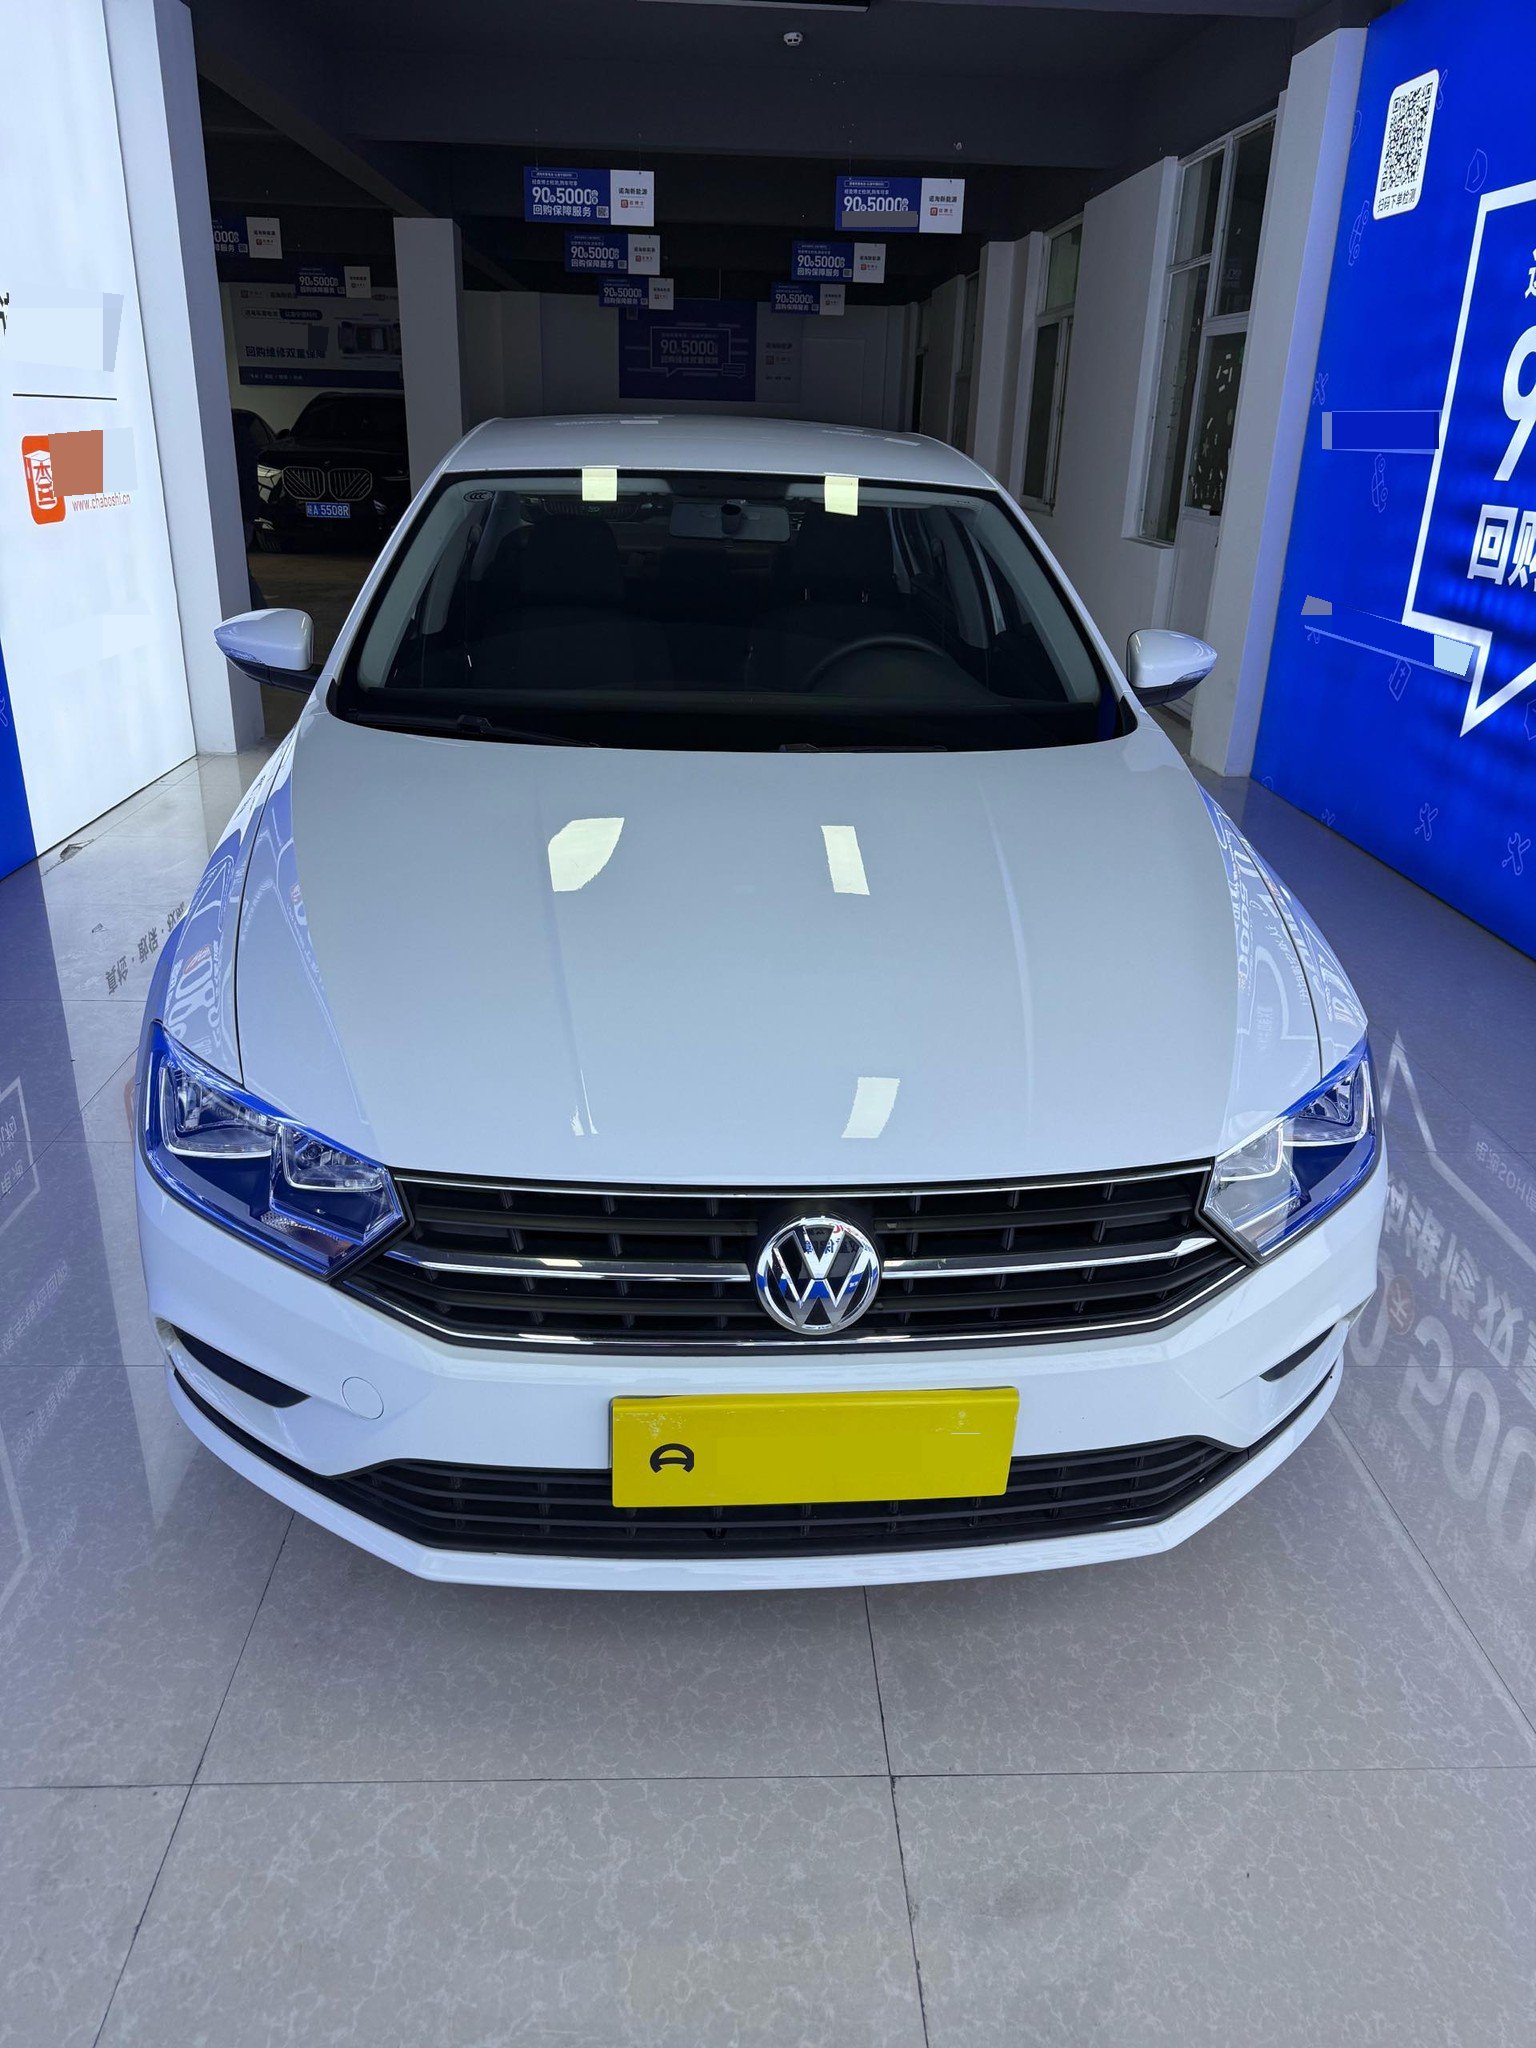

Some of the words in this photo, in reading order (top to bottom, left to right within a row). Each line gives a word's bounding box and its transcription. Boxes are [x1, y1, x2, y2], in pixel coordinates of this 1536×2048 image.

[532, 204, 592, 218] 回购保障服务
[72, 491, 131, 512] www.chaboshi.cn
